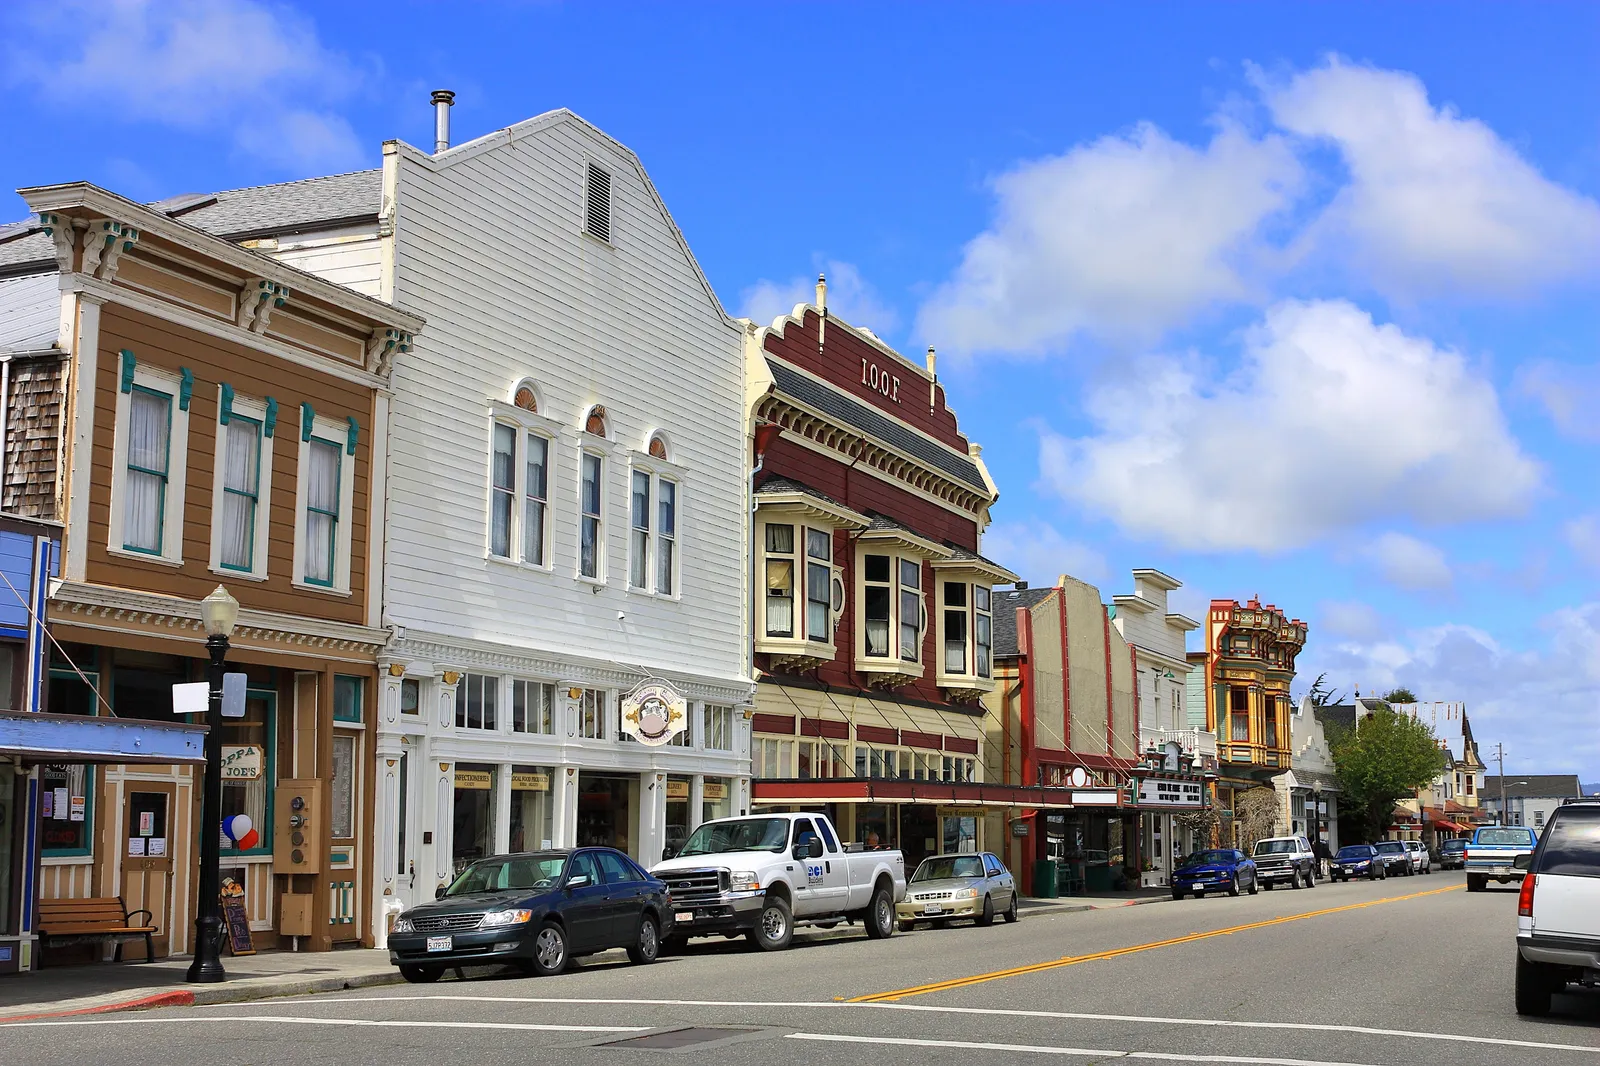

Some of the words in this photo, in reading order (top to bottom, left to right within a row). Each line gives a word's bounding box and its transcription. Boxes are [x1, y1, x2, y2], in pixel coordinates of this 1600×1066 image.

[861, 357, 902, 404] I.O.O.F.
[220, 746, 256, 768] OPPA
[226, 767, 256, 777] JOE'S
[954, 808, 985, 817] Remembered
